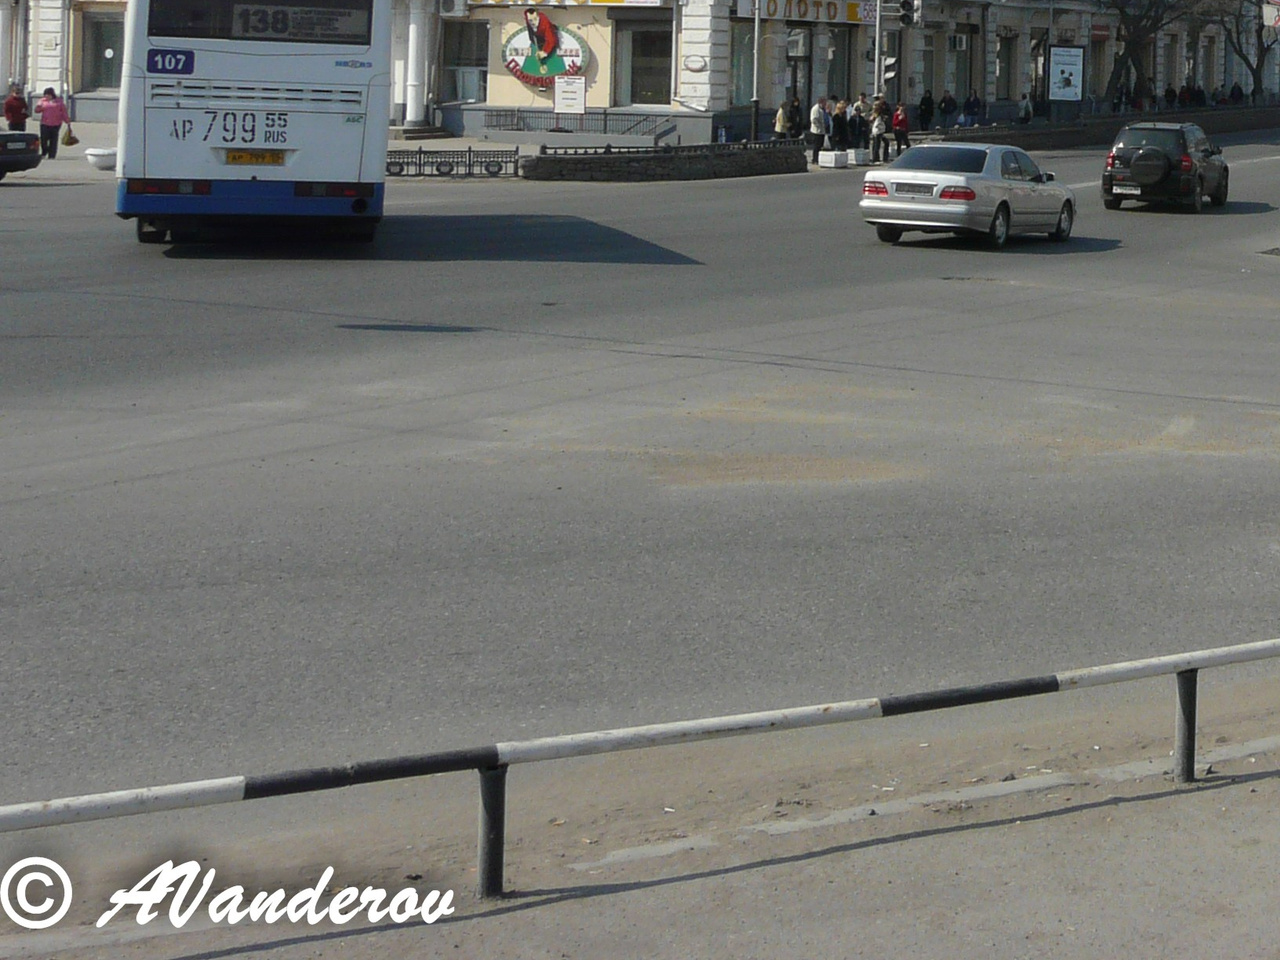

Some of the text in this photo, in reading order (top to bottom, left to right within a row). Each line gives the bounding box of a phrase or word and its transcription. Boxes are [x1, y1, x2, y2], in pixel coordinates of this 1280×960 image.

[238, 9, 290, 33] 138
[155, 54, 186, 70] 107
[203, 111, 256, 143] 799
[265, 113, 288, 128] 55
[264, 131, 287, 144] RUS
